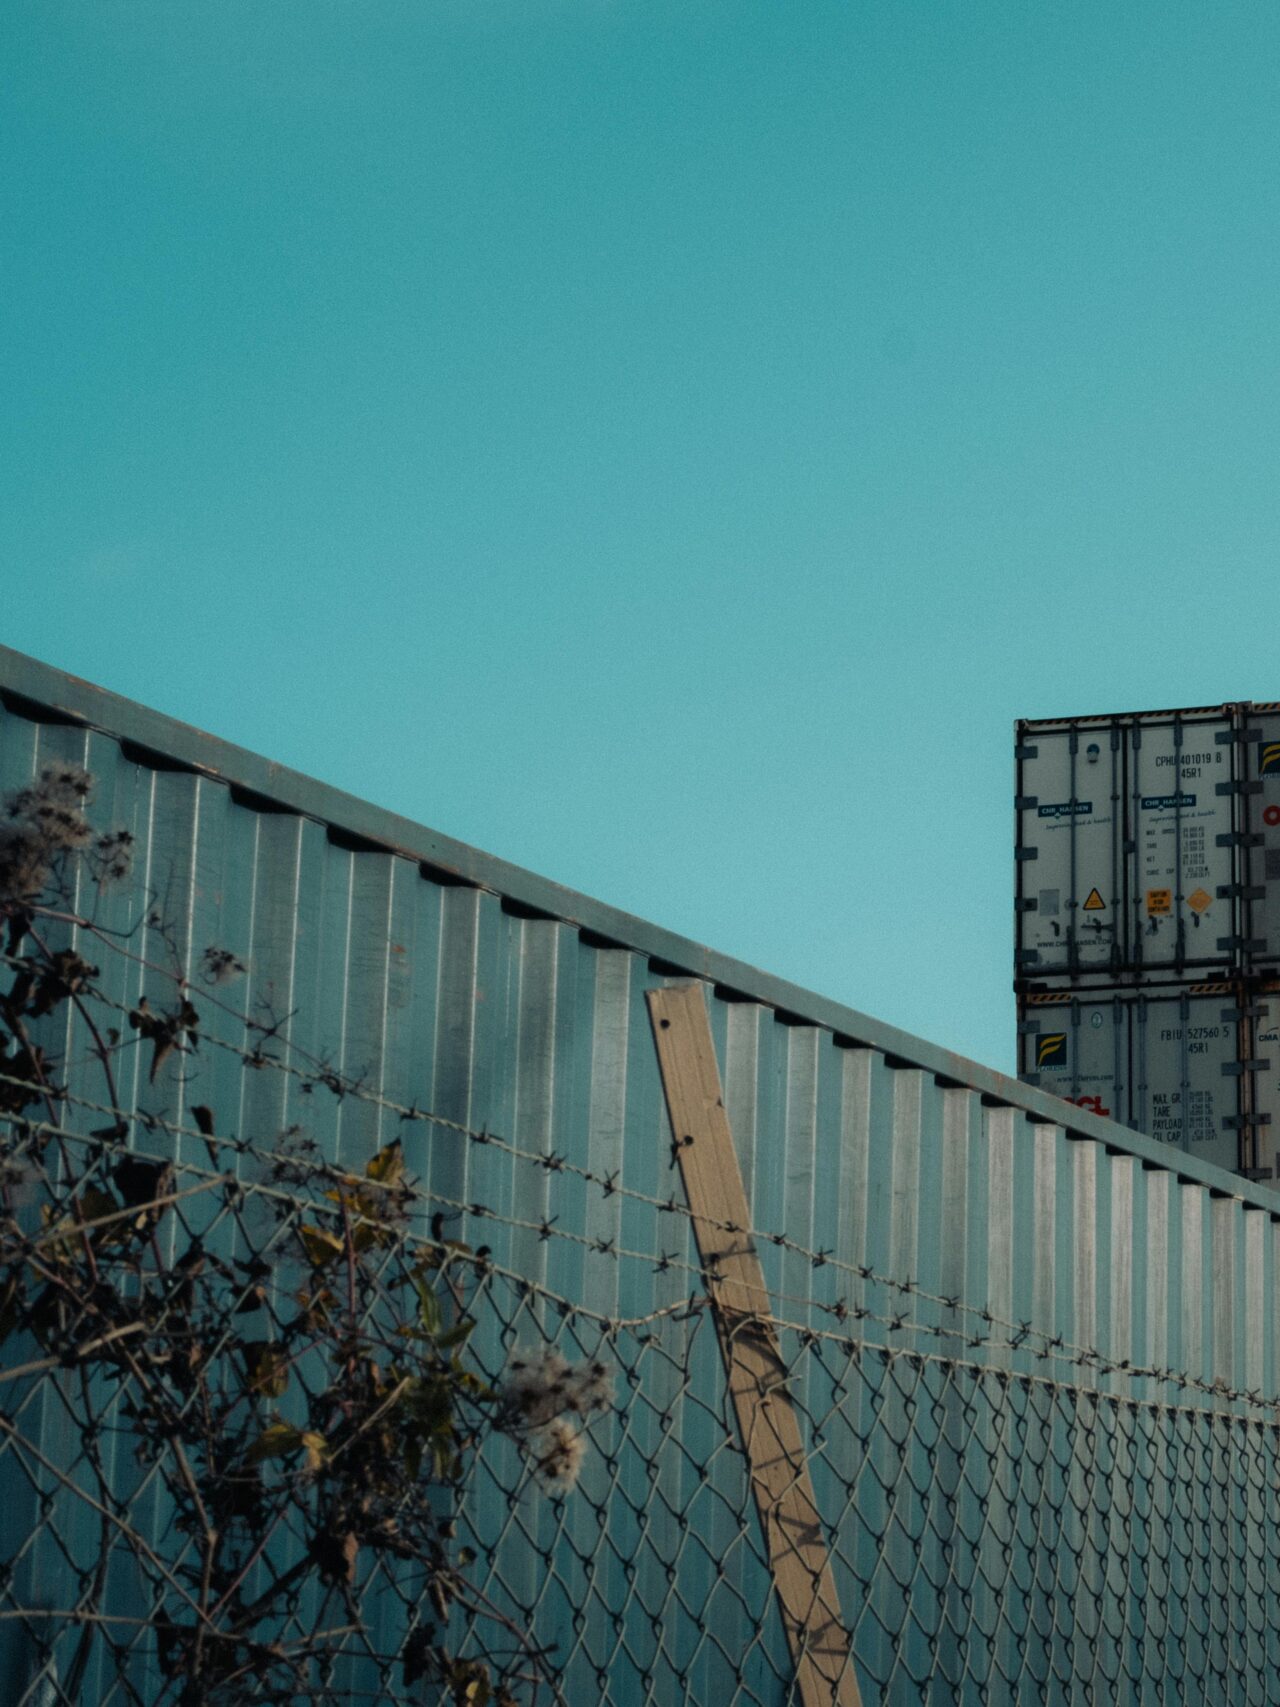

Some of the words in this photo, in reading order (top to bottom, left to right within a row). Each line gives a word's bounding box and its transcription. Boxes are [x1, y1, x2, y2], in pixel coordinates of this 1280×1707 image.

[1180, 753, 1212, 765] 401019
[1181, 768, 1202, 778] 45R1
[1060, 804, 1090, 812] HASEN
[1160, 1030, 1182, 1040] FBIU
[1188, 1027, 1219, 1039] 527560
[1223, 1026, 1230, 1038] 5
[1258, 1034, 1278, 1042] CMA
[1188, 1043, 1209, 1054] 45R1
[1153, 1094, 1167, 1105] MAX
[1063, 1096, 1110, 1116] CL
[1153, 1106, 1170, 1118] TARE
[1153, 1119, 1183, 1131] PAYLOAD
[1167, 1131, 1182, 1142] CAP
